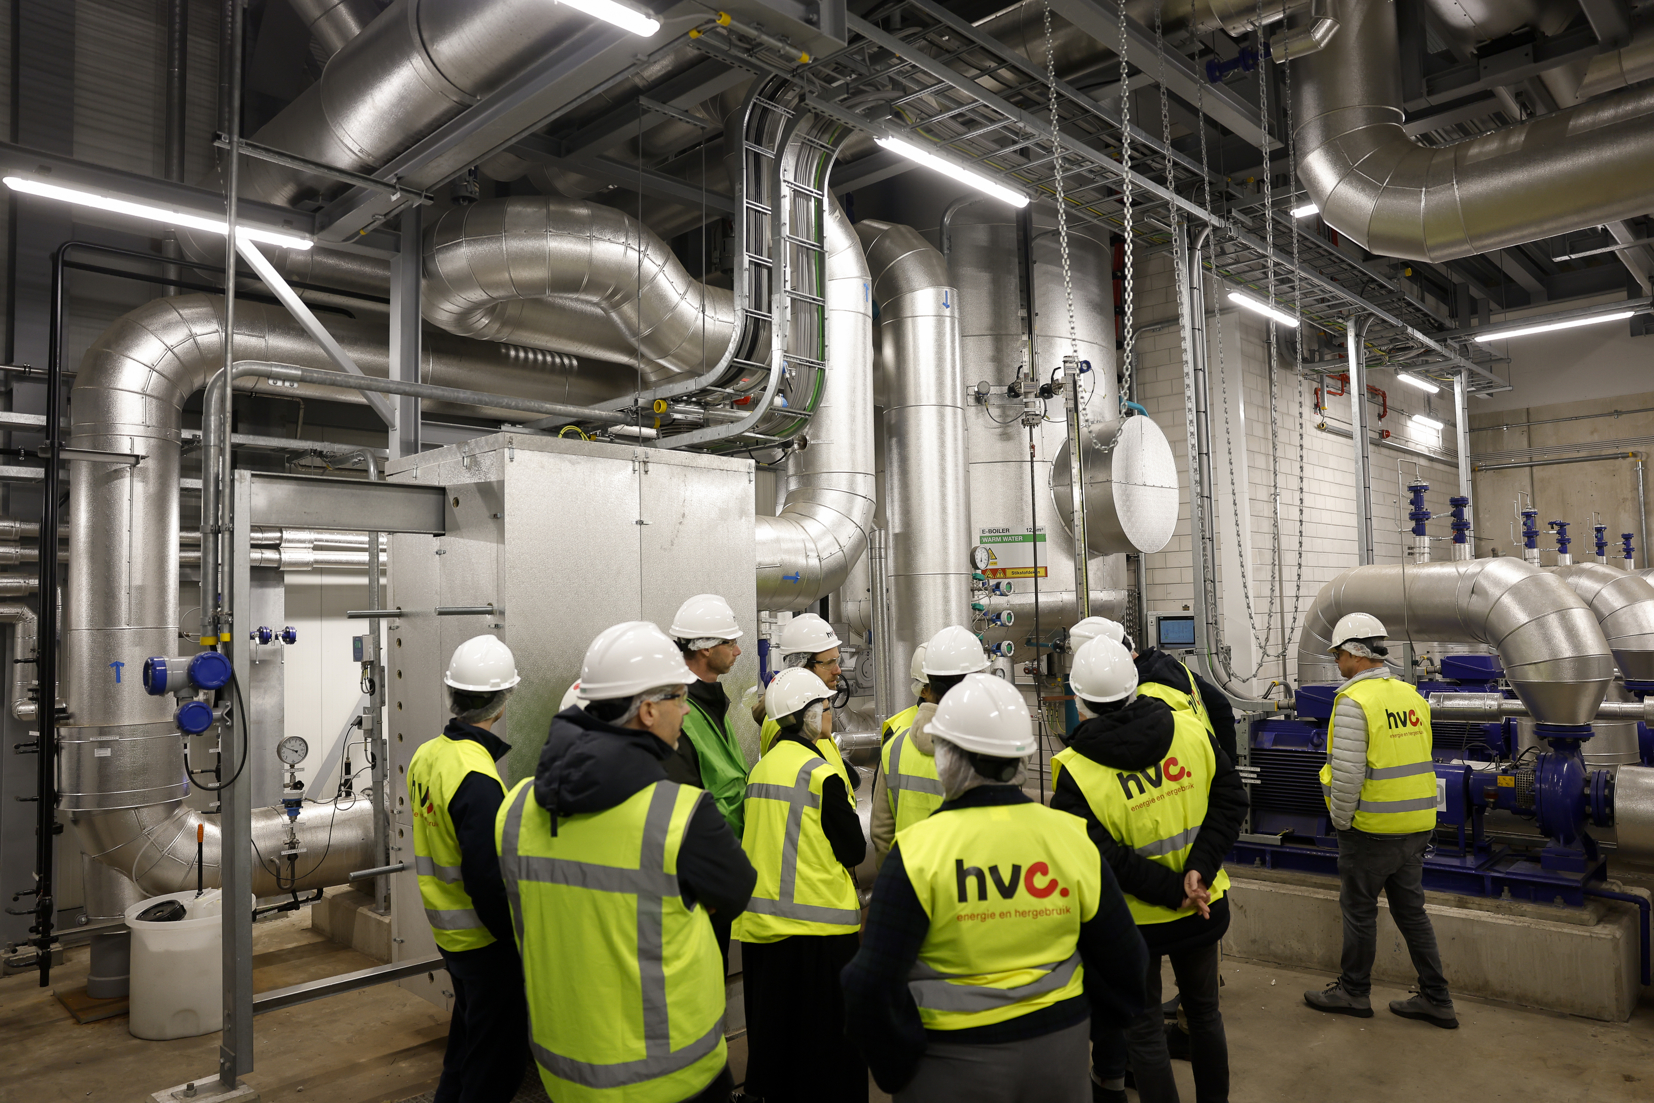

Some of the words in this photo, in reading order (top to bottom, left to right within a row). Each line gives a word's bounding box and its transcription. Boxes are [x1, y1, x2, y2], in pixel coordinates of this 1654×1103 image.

[1385, 709, 1423, 729] hvc.
[1130, 797, 1156, 812] energie
[955, 859, 1070, 903] hvc.
[957, 909, 996, 922] energie
[999, 910, 1011, 919] en
[1015, 905, 1071, 920] hergebruik
